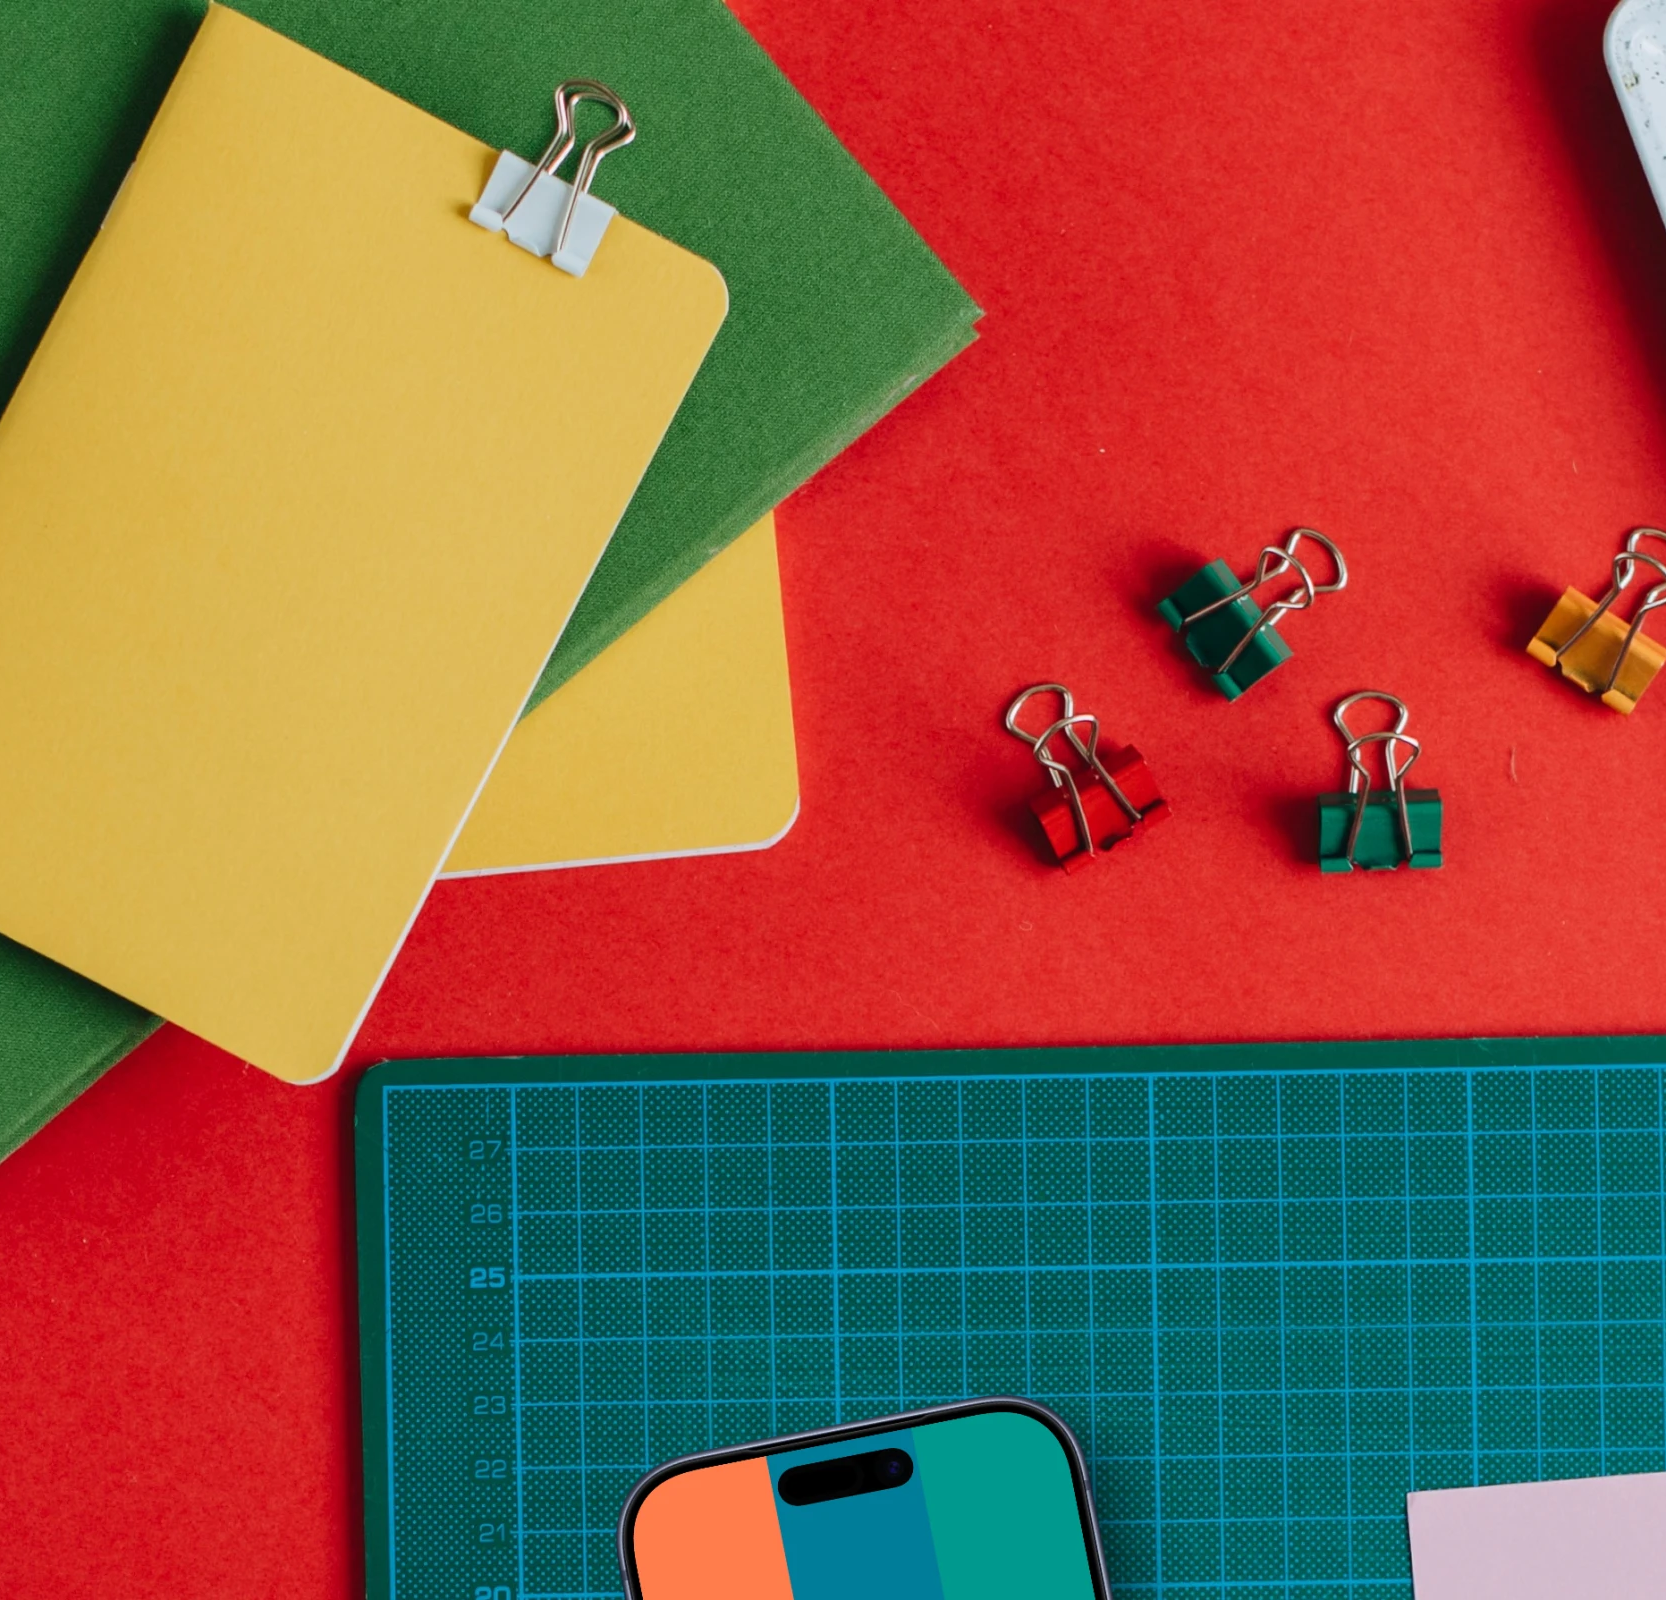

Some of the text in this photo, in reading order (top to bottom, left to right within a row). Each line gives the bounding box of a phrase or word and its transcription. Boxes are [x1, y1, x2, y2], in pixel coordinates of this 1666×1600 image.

[469, 1141, 502, 1160] 27
[470, 1205, 502, 1224] 26
[470, 1268, 505, 1288] 25
[472, 1333, 505, 1352] 24
[474, 1396, 506, 1416] 23
[474, 1459, 507, 1479] 22
[479, 1523, 505, 1543] 21
